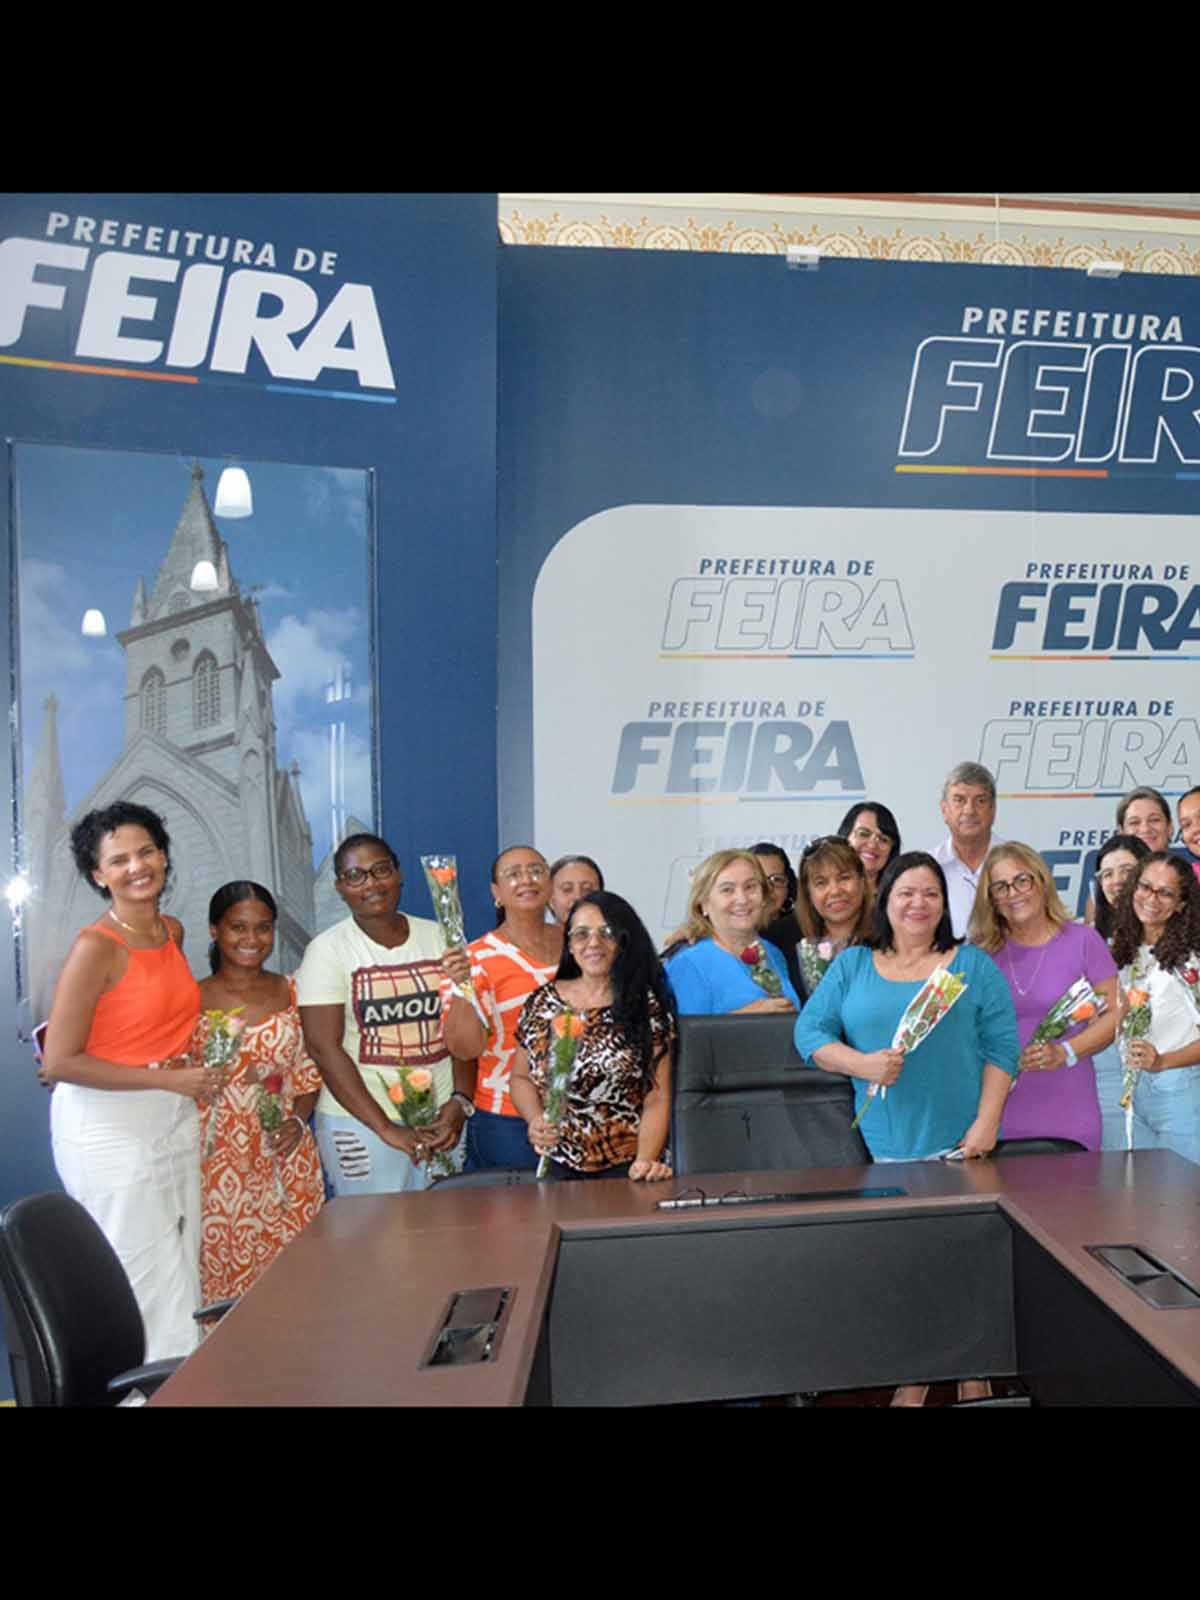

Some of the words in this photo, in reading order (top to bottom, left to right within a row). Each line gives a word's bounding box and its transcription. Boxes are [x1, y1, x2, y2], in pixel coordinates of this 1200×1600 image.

[47, 211, 276, 268] PREFEITURA
[293, 248, 338, 276] DE
[0, 237, 397, 389] FEIRA
[961, 306, 1184, 343] PREFEITURA
[699, 558, 836, 577] PREFEITURA
[846, 558, 874, 577] DE
[1026, 562, 1155, 580] PREFEITURA
[1164, 564, 1191, 580] DE
[660, 576, 915, 651] FEIRA
[647, 700, 792, 719] PREFEITURA
[797, 700, 826, 718] DE
[1009, 700, 1138, 717] PREFEITURA
[1147, 700, 1174, 717] DE
[611, 719, 866, 794] FEIRA
[364, 997, 441, 1023] AMOU
